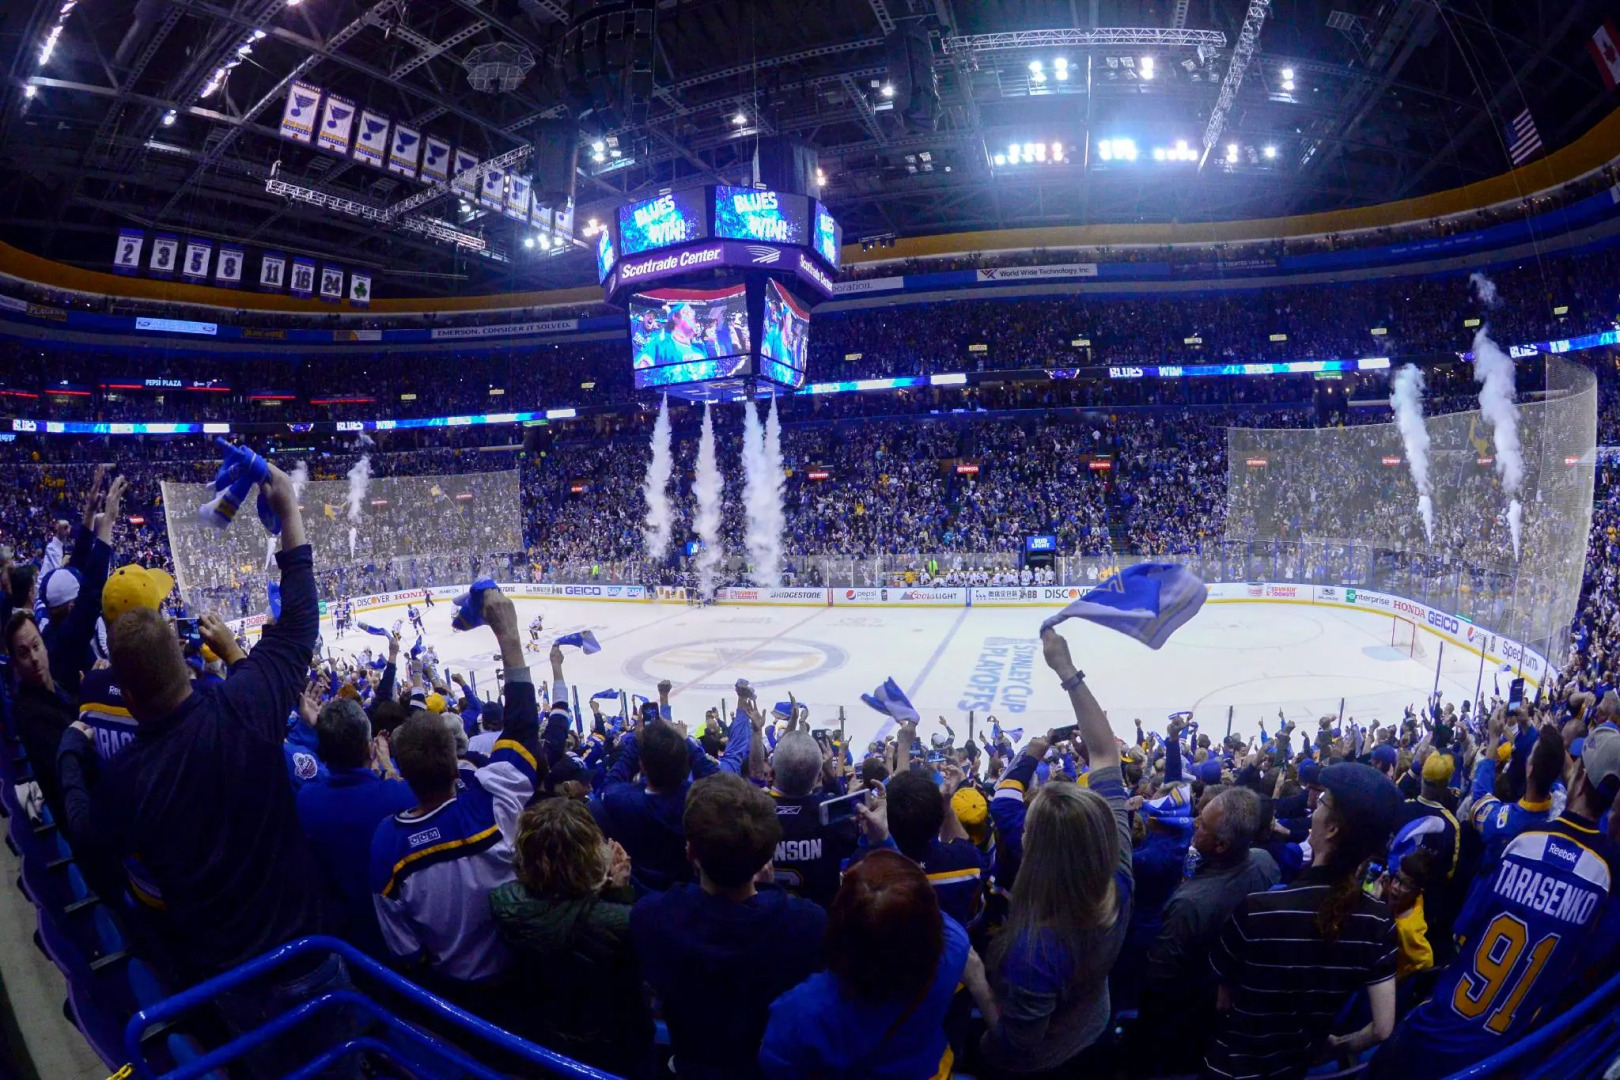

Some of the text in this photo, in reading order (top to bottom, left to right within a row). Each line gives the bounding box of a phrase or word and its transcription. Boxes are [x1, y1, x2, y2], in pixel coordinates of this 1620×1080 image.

[633, 195, 676, 227] BLUES
[733, 192, 778, 214] BLUES
[648, 218, 686, 243] WIN!
[749, 217, 787, 240] WIN!
[122, 243, 134, 263] 2
[157, 246, 171, 268] 3
[190, 252, 204, 272] 5
[223, 257, 236, 277] 8
[265, 263, 279, 283] 11
[621, 248, 720, 279] Scottrade Center
[799, 253, 819, 279] Scottrade
[323, 274, 340, 294] 24
[483, 326, 525, 335] CONSIDER
[527, 325, 535, 333] IT
[1509, 344, 1538, 358] BLUES
[1109, 367, 1143, 378] BLUES
[145, 379, 182, 387] PEPSI PLAZA
[336, 421, 363, 431] BLUES
[356, 595, 390, 607] DISCOVER
[565, 586, 601, 596] GEICO
[770, 591, 822, 599] BRIDGESTONE
[857, 590, 877, 598] pepsi
[935, 592, 958, 600] LIGHT
[1044, 588, 1088, 599] DISCOVE
[1350, 592, 1391, 606] enterprise
[1393, 599, 1426, 619] HONDA
[1427, 610, 1459, 635] GEICO
[1007, 645, 1038, 684] STANLEY
[957, 648, 1008, 712] PLAYOFFS
[1000, 685, 1034, 713] CUP
[409, 829, 440, 847] CCM
[1548, 843, 1579, 864] Reebok
[1493, 860, 1599, 925] TARASENKO
[1450, 910, 1562, 1036] 91
